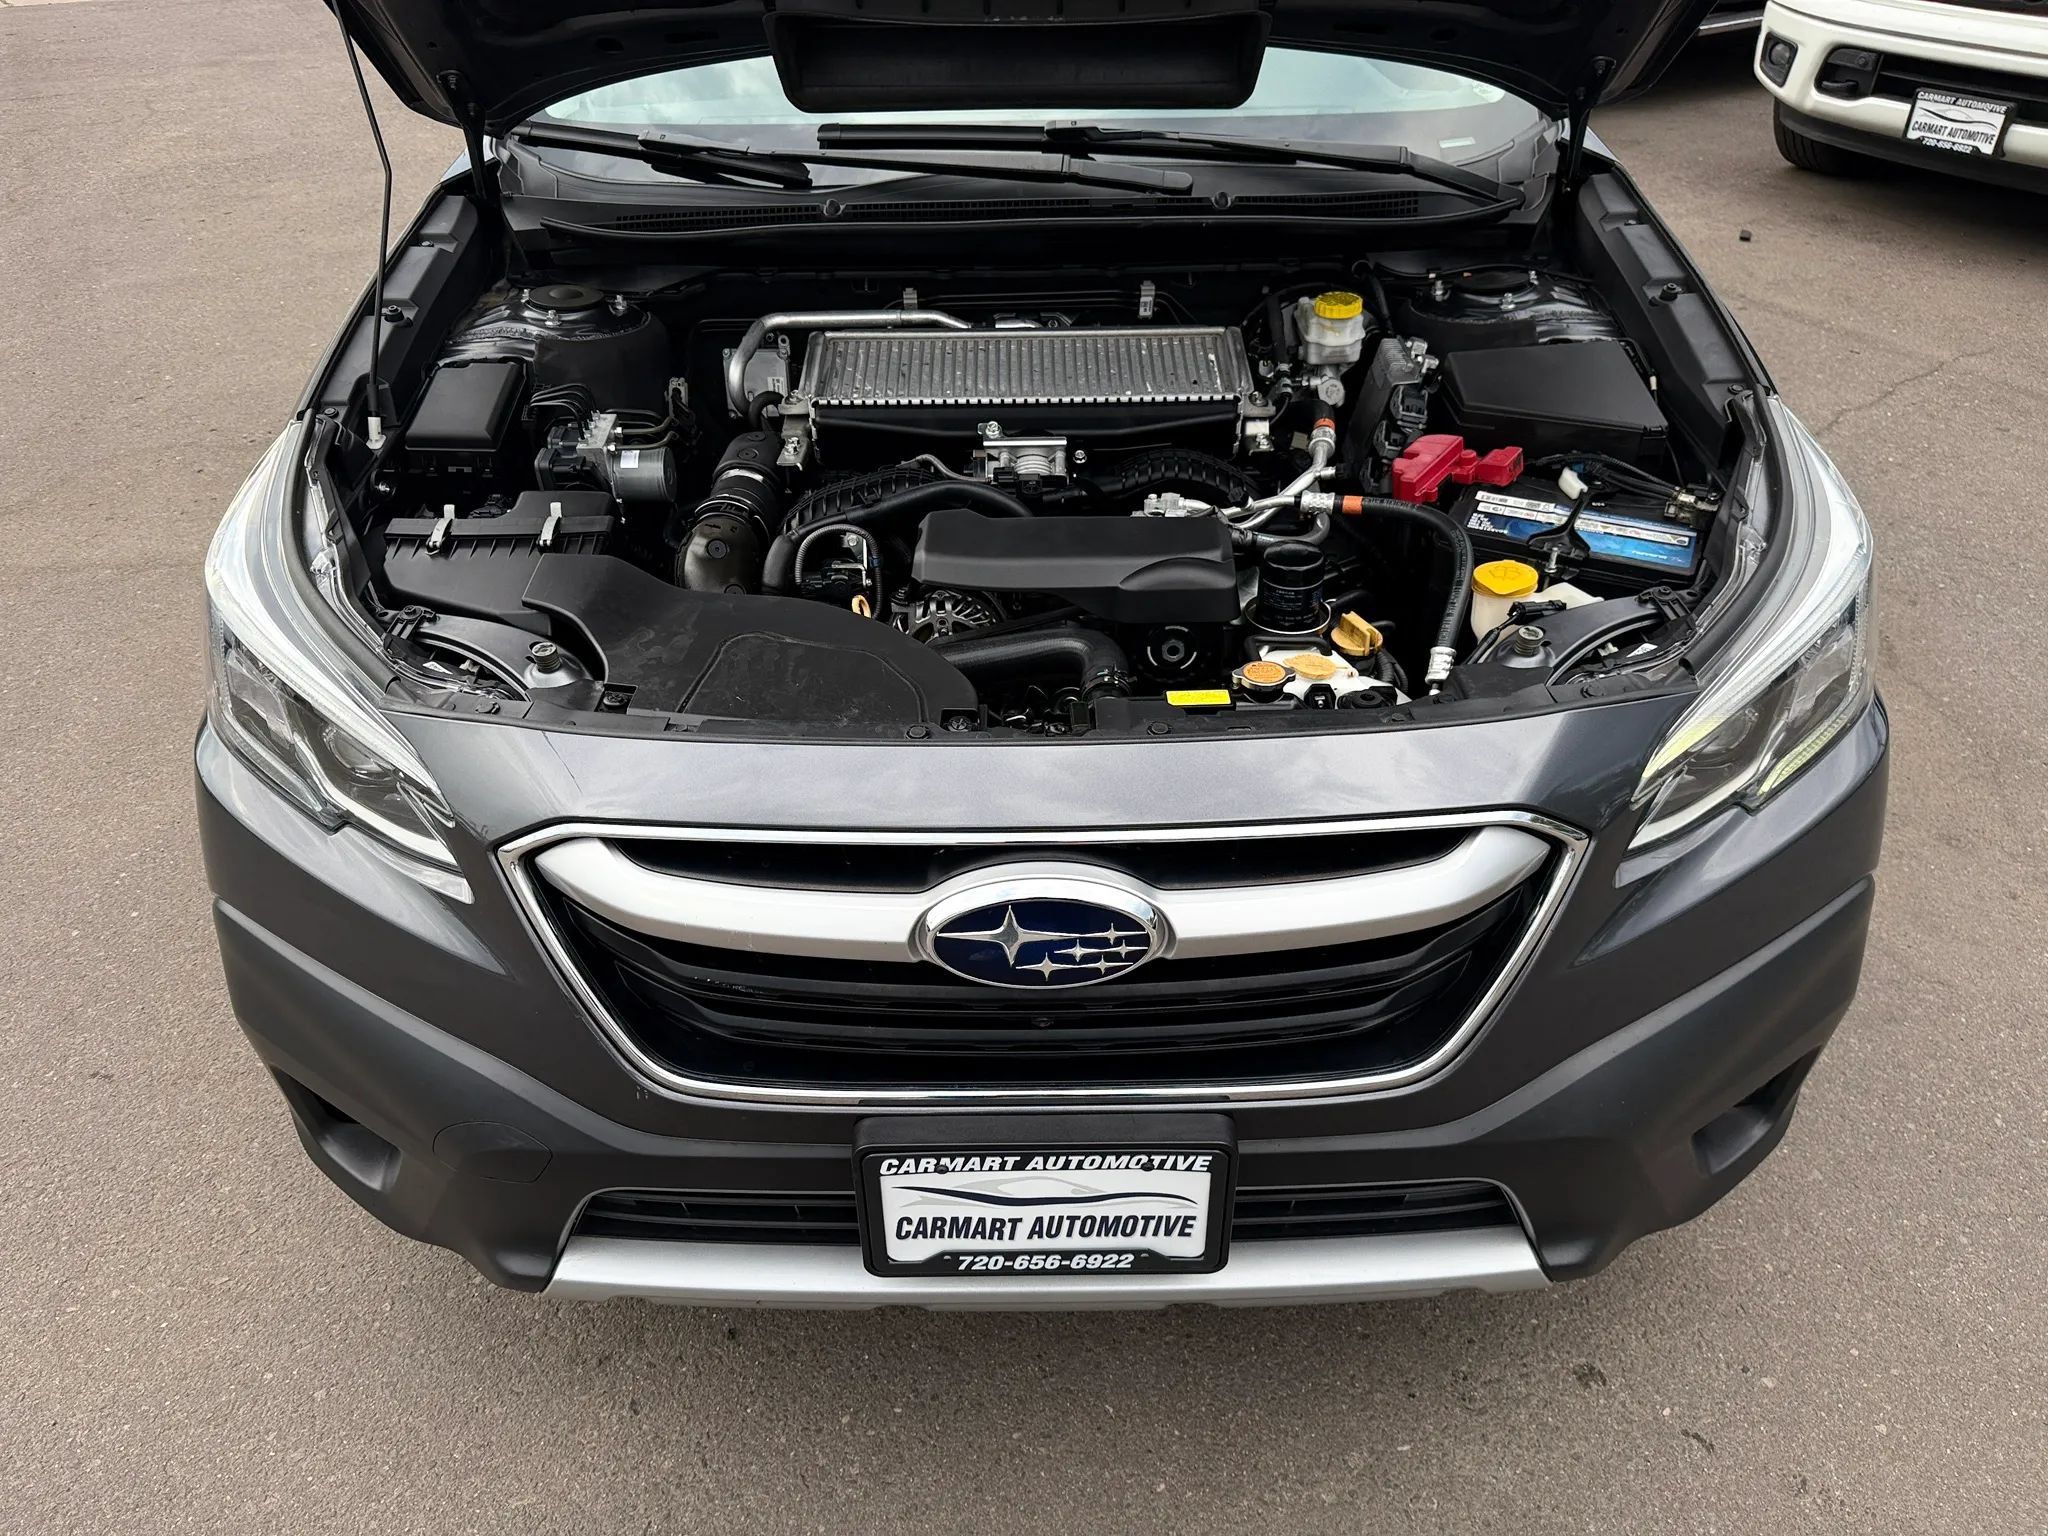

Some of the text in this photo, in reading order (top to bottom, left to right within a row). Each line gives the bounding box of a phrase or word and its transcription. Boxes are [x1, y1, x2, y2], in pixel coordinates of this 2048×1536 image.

[1917, 92, 2007, 113] CARMART AUTOMOTIVE
[1912, 121, 1995, 145] CARMART AUTOMOTIVE
[879, 1155, 1212, 1175] CARMART AUTOMOTIVE
[895, 1214, 1198, 1240] CARMART AUTOMOTIVE
[957, 1253, 1135, 1271] 720-656-6922
